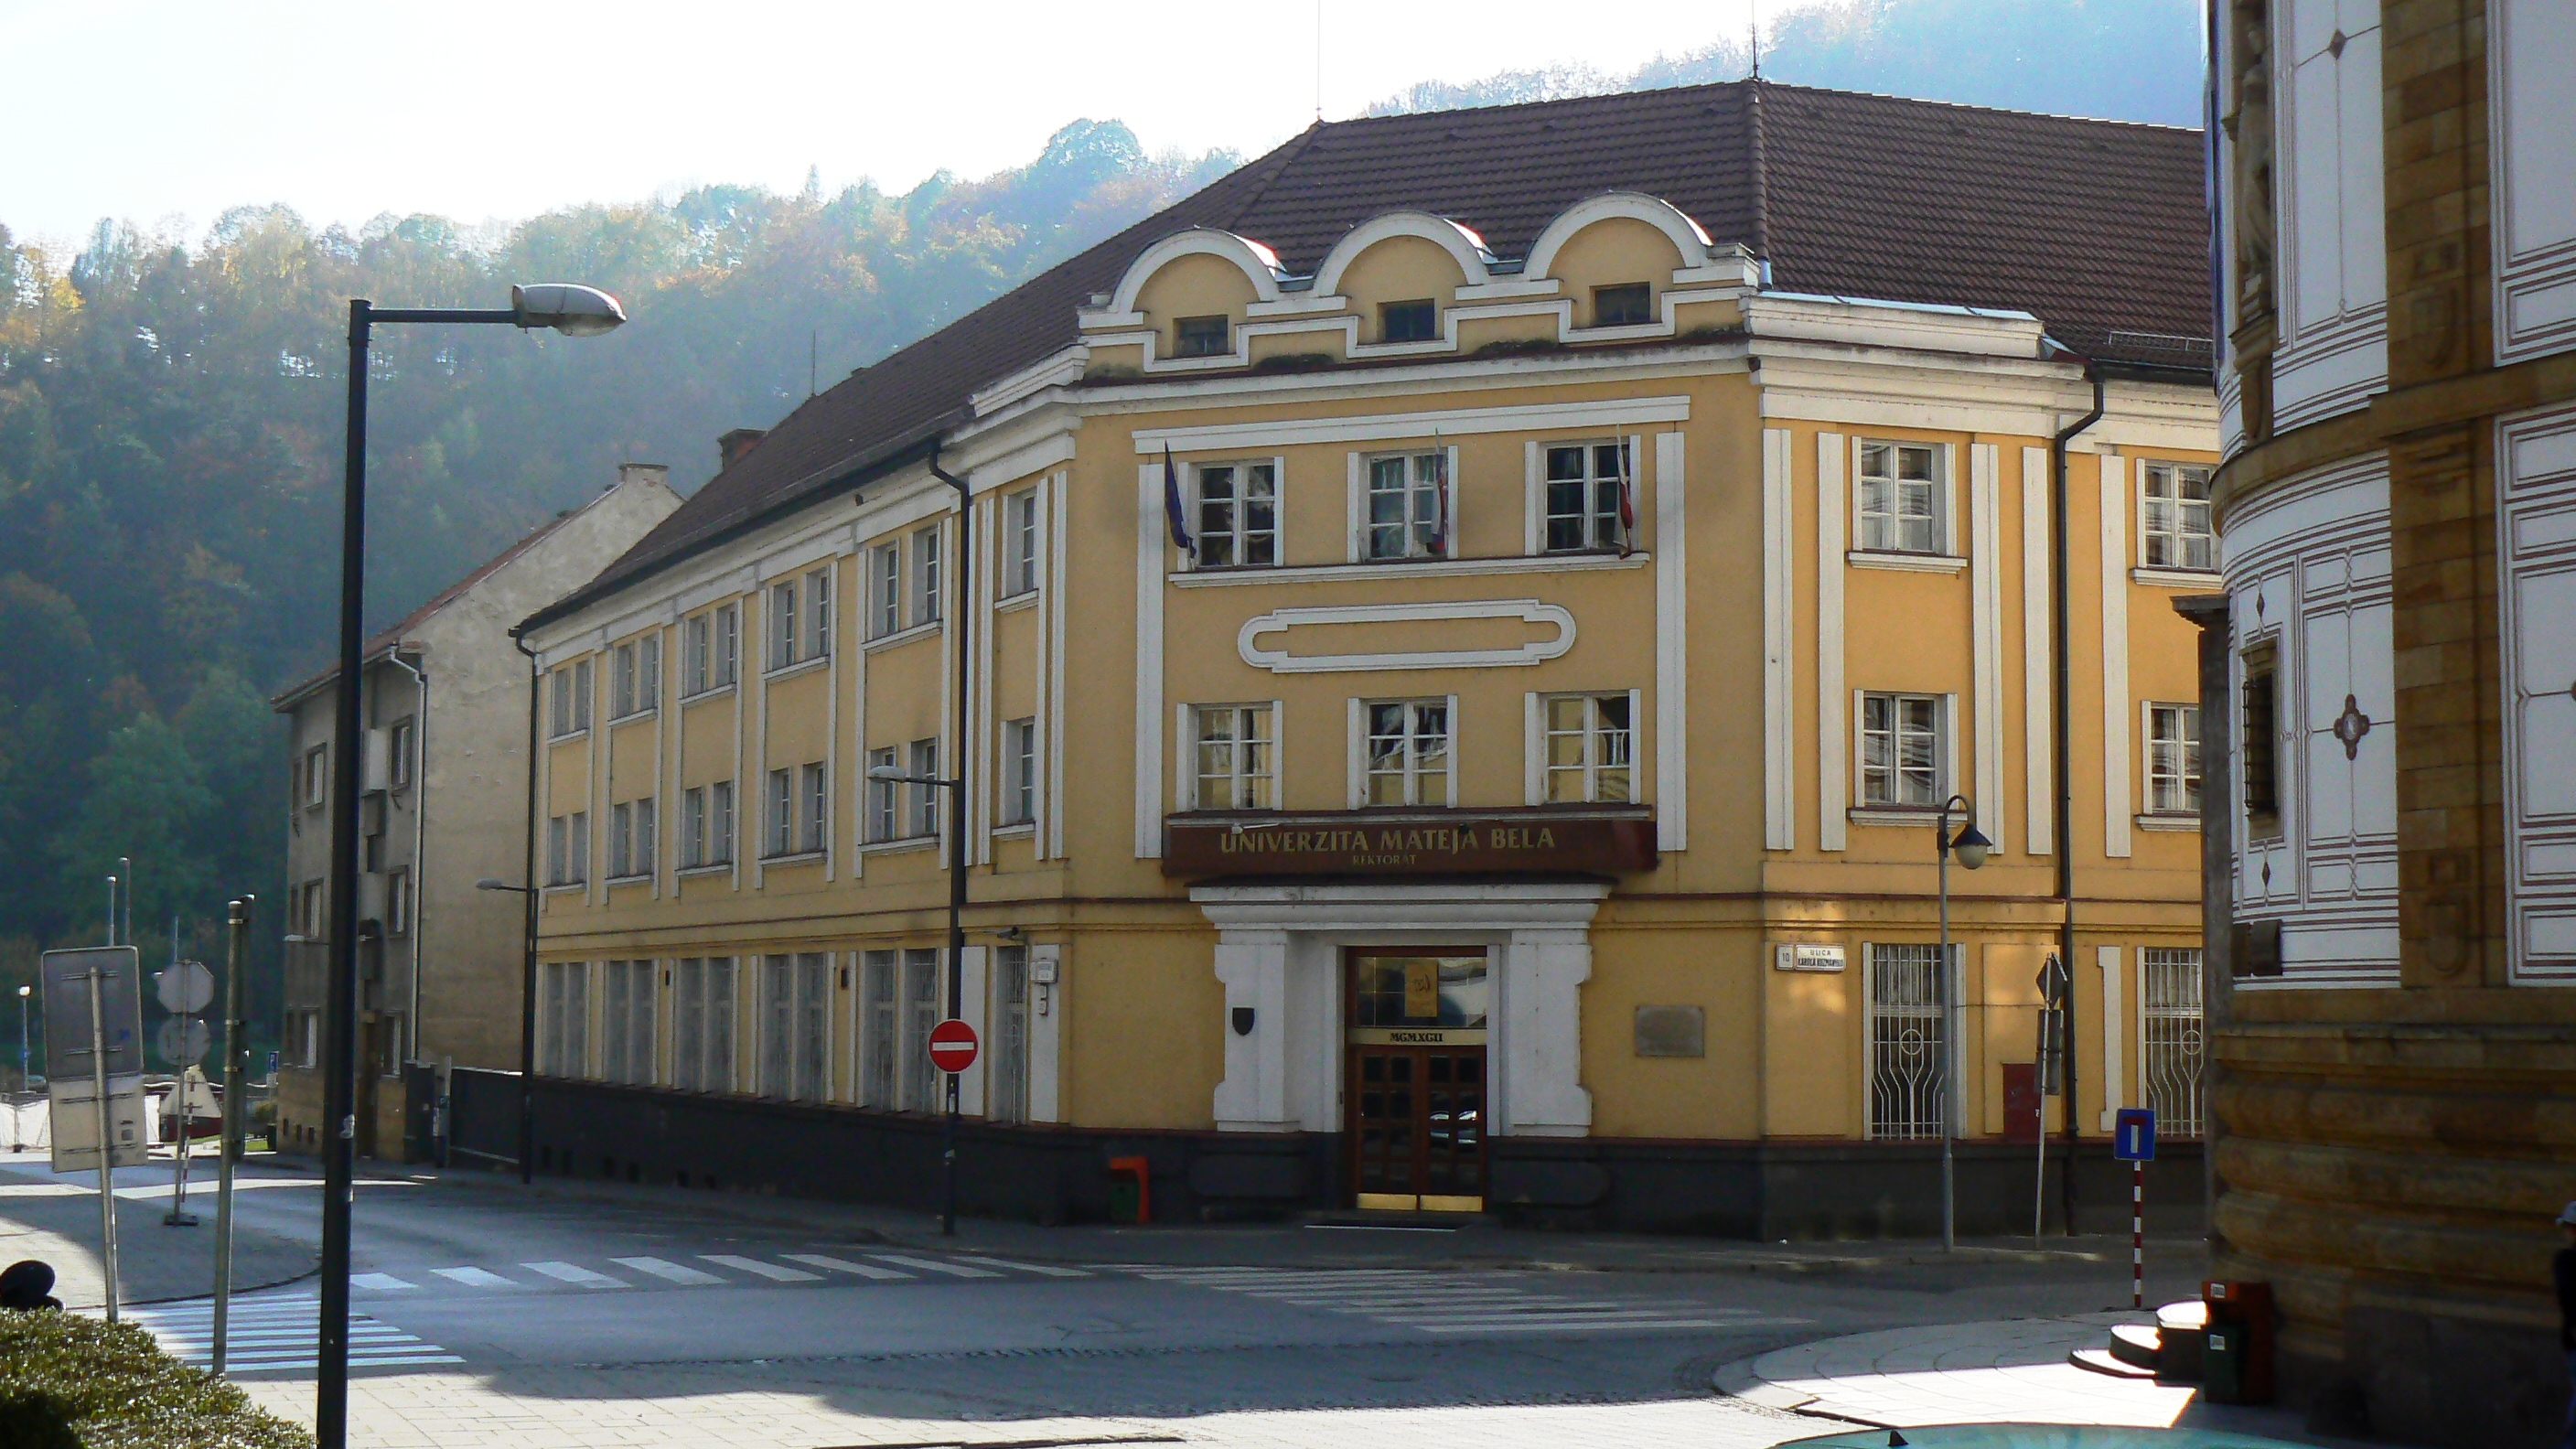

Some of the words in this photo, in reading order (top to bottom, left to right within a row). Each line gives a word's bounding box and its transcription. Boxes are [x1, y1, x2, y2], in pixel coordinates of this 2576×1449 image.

[1220, 831, 1369, 853] UNIVERZITA
[1379, 828, 1479, 855] MATEJA
[1491, 827, 1555, 849] BELA
